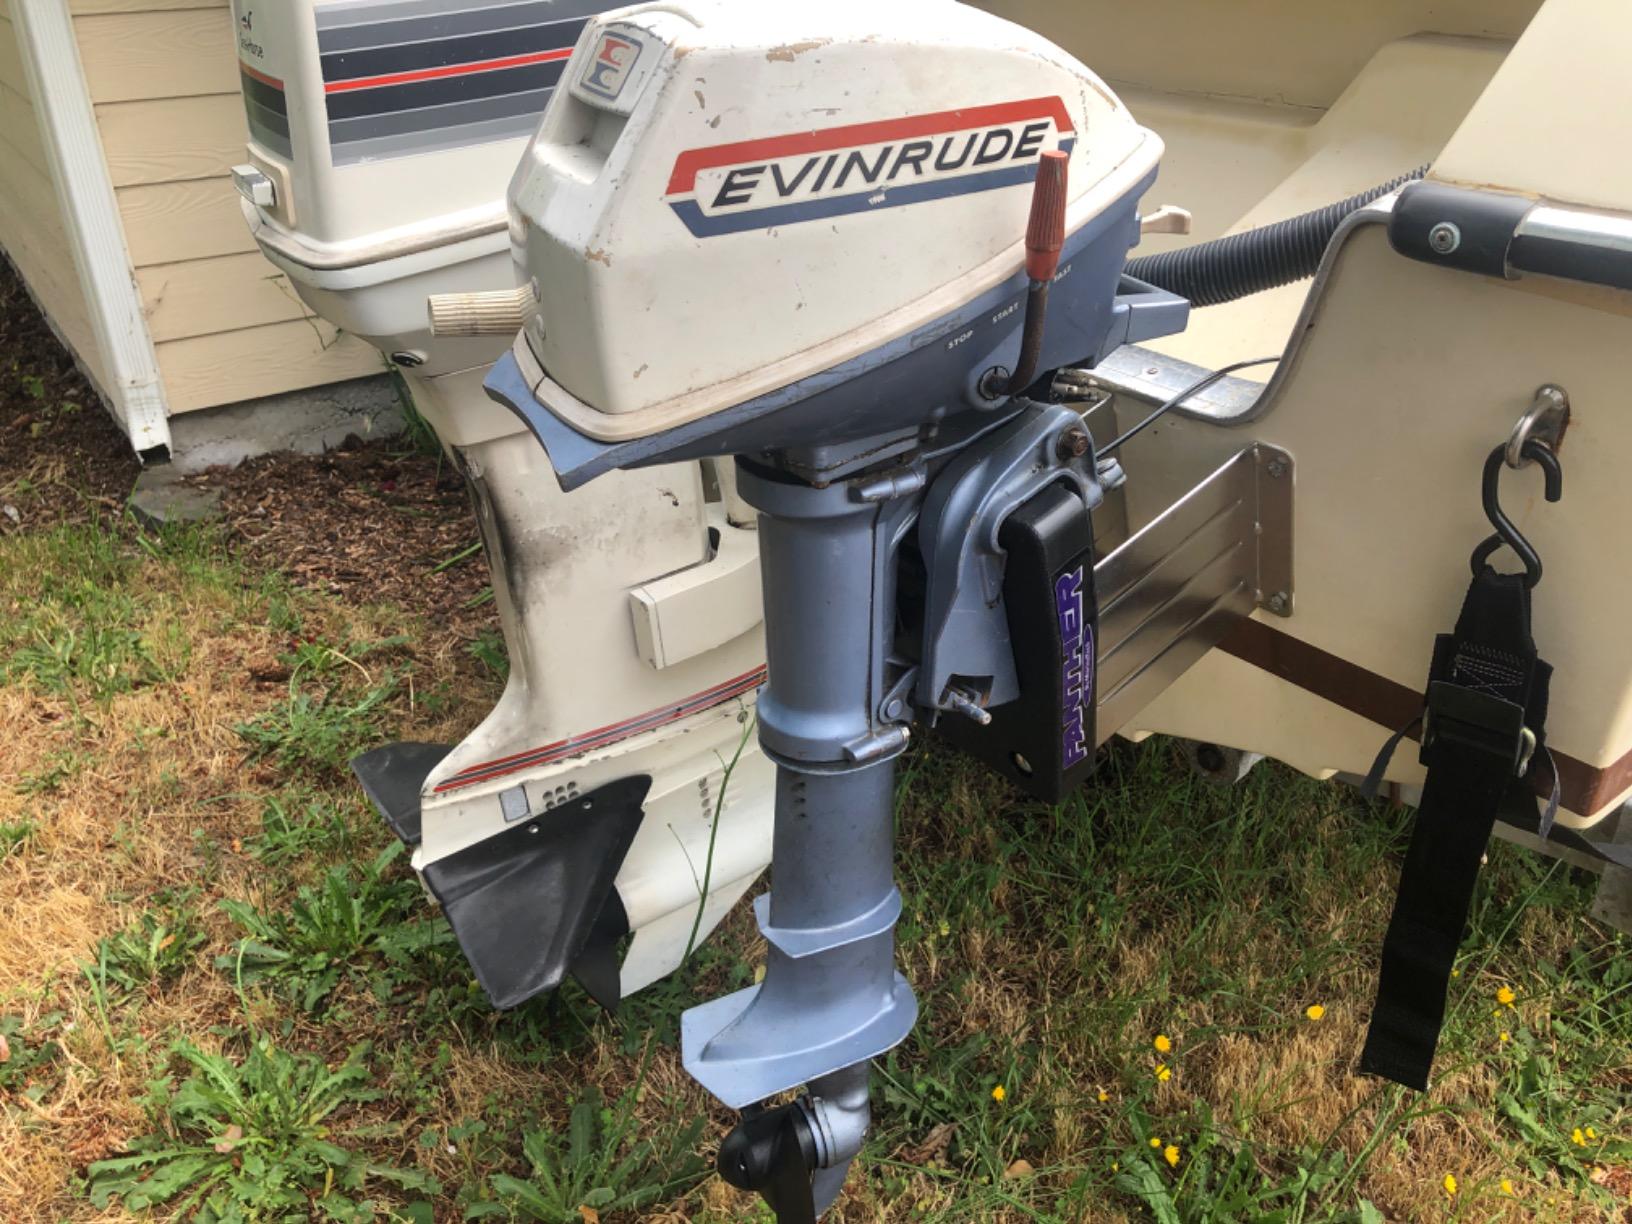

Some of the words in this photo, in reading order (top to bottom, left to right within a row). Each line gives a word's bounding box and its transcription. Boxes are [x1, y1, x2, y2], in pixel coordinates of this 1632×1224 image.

[711, 120, 1050, 208] EVINRUDE
[948, 329, 974, 350] STOP
[991, 302, 1019, 325] START
[1055, 565, 1088, 770] PANTHER
